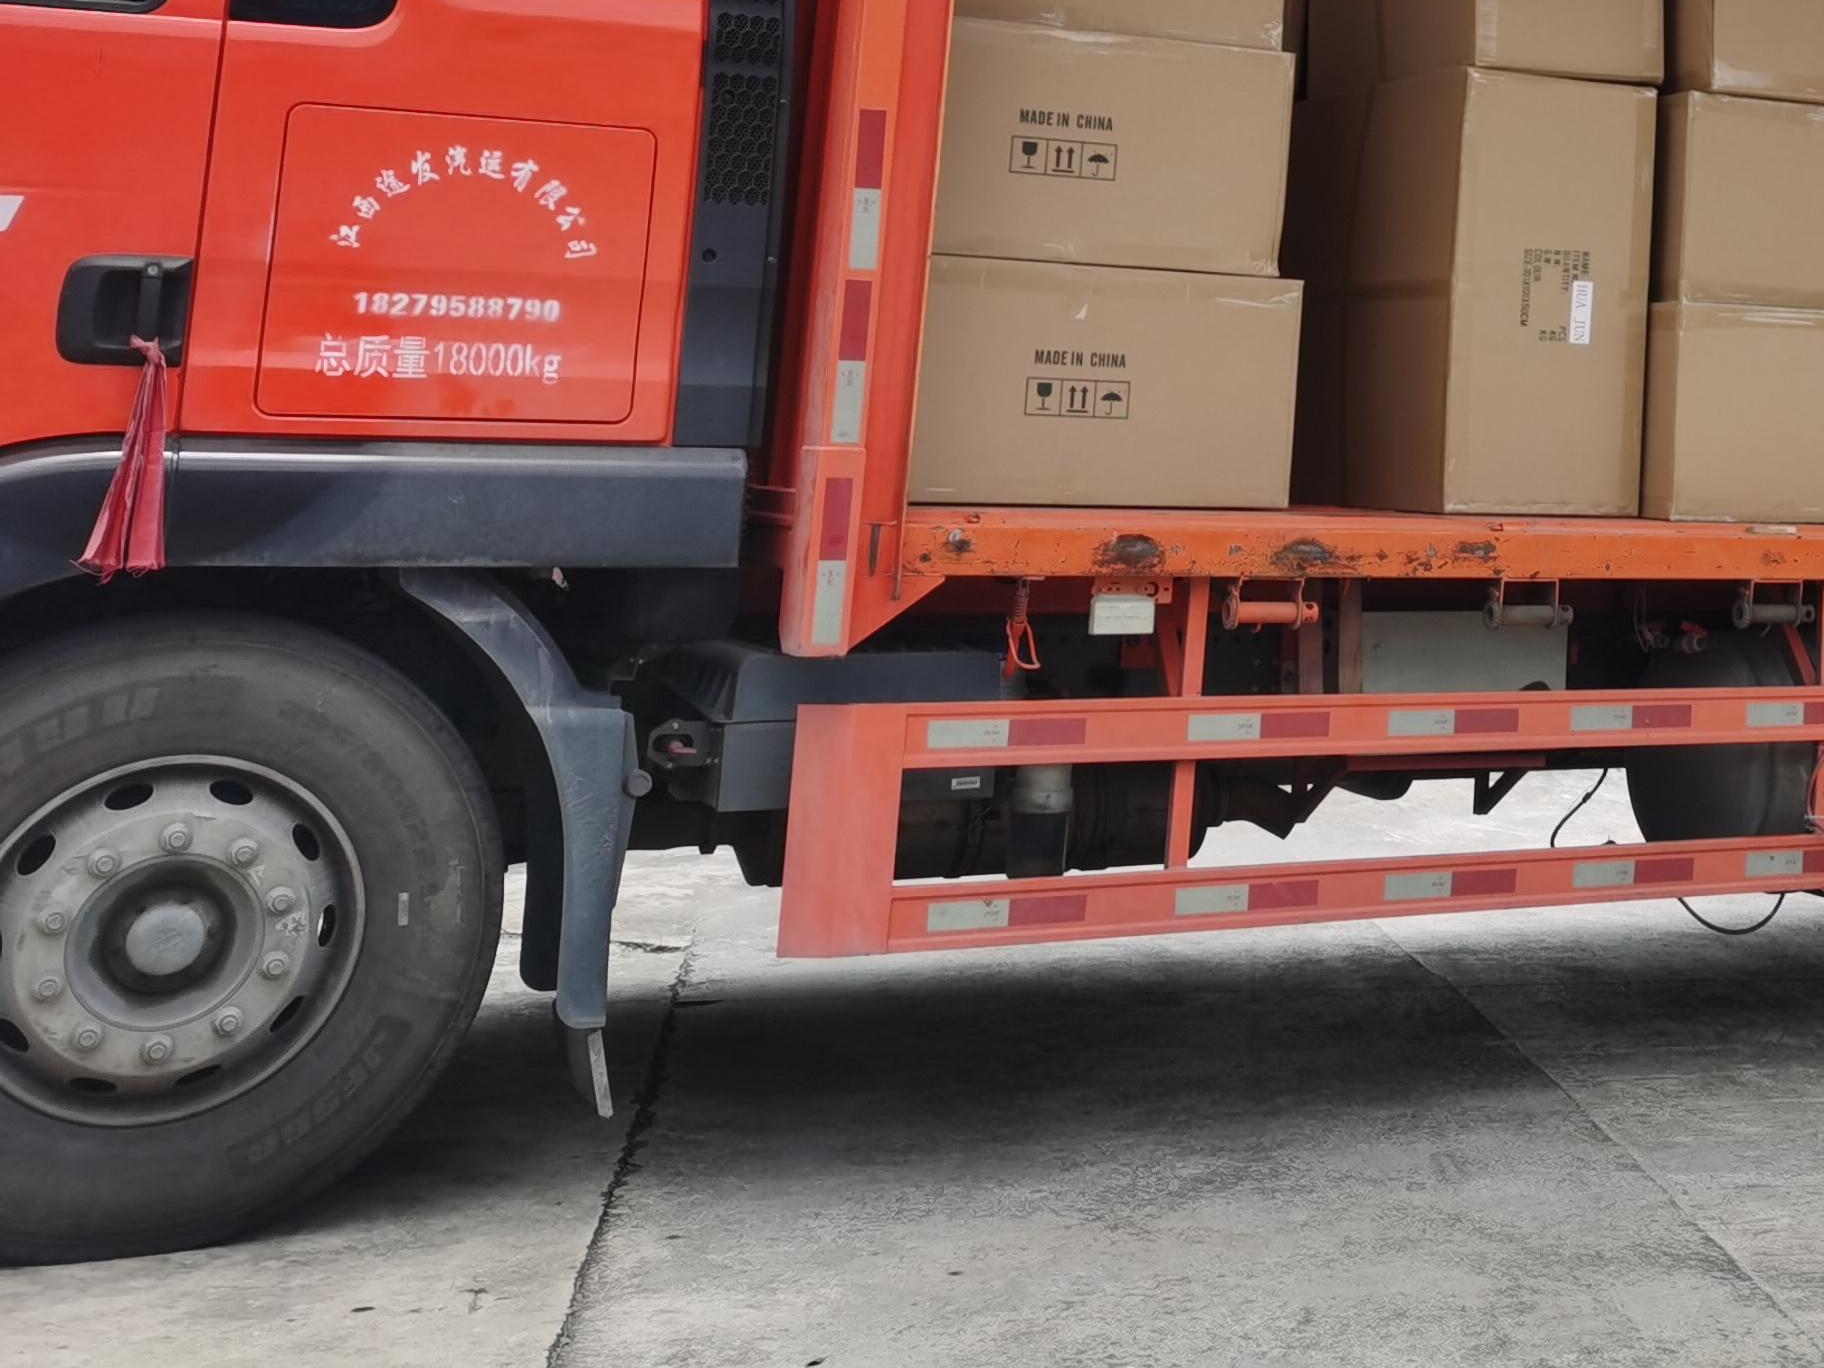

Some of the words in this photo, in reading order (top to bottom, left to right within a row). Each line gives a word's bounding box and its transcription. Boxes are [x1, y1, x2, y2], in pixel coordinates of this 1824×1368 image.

[1019, 108, 1054, 126] MADE
[1057, 112, 1070, 127] IN
[1076, 114, 1113, 131] CHINA
[1572, 250, 1580, 271] ITEM
[353, 291, 561, 322] 18279588790
[1575, 284, 1588, 309] HUA
[1573, 317, 1586, 342] JUN
[314, 333, 562, 384] 总质量18000kg
[1034, 349, 1067, 365] MADE
[1070, 351, 1083, 367] IN
[1090, 352, 1126, 368] CHINA
